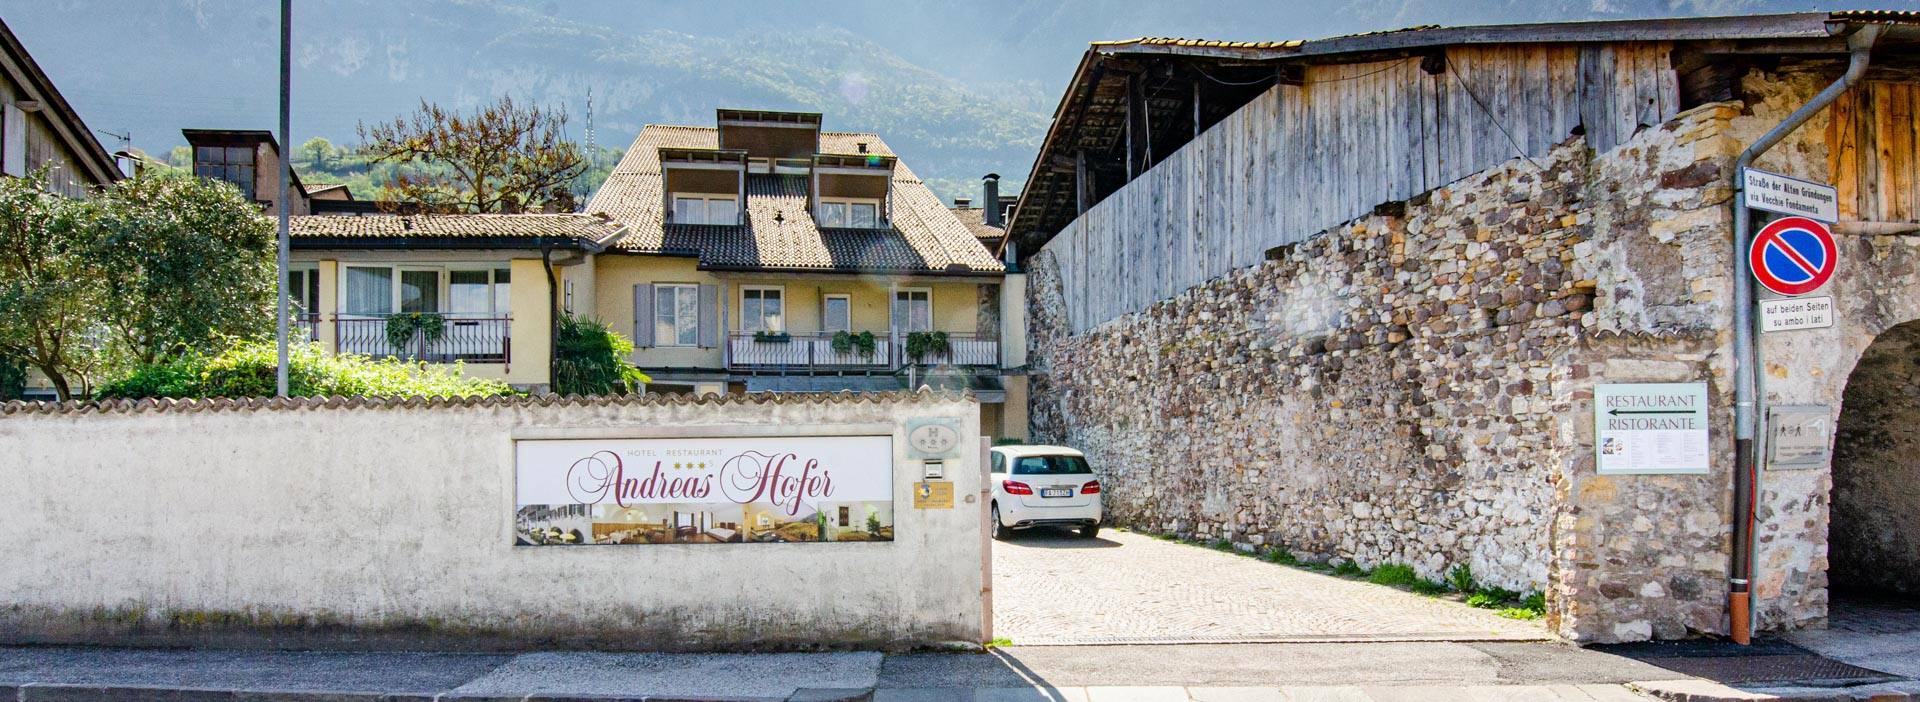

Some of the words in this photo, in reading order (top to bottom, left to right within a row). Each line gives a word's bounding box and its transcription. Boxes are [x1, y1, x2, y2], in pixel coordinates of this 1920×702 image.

[1749, 175, 1770, 189] Straße
[1772, 181, 1781, 191] der
[1784, 183, 1799, 195] Alten
[1801, 187, 1833, 204] Gründungen
[1750, 191, 1759, 201] via
[1762, 193, 1784, 207] Vecchie
[1785, 198, 1819, 214] Fondamenta
[1766, 305, 1777, 314] auf
[1780, 304, 1804, 313] beiden
[1806, 302, 1829, 312] Seiten
[1773, 319, 1782, 327] su
[1784, 316, 1804, 326] ambo
[1811, 314, 1823, 324] lati
[1606, 394, 1697, 408] RESTAURANT
[1609, 417, 1696, 430] RISTORANTE
[627, 449, 657, 457] HOTEL
[666, 448, 723, 456] RESTAURANT
[566, 450, 713, 509] Andreas
[719, 450, 836, 516] Hofer
